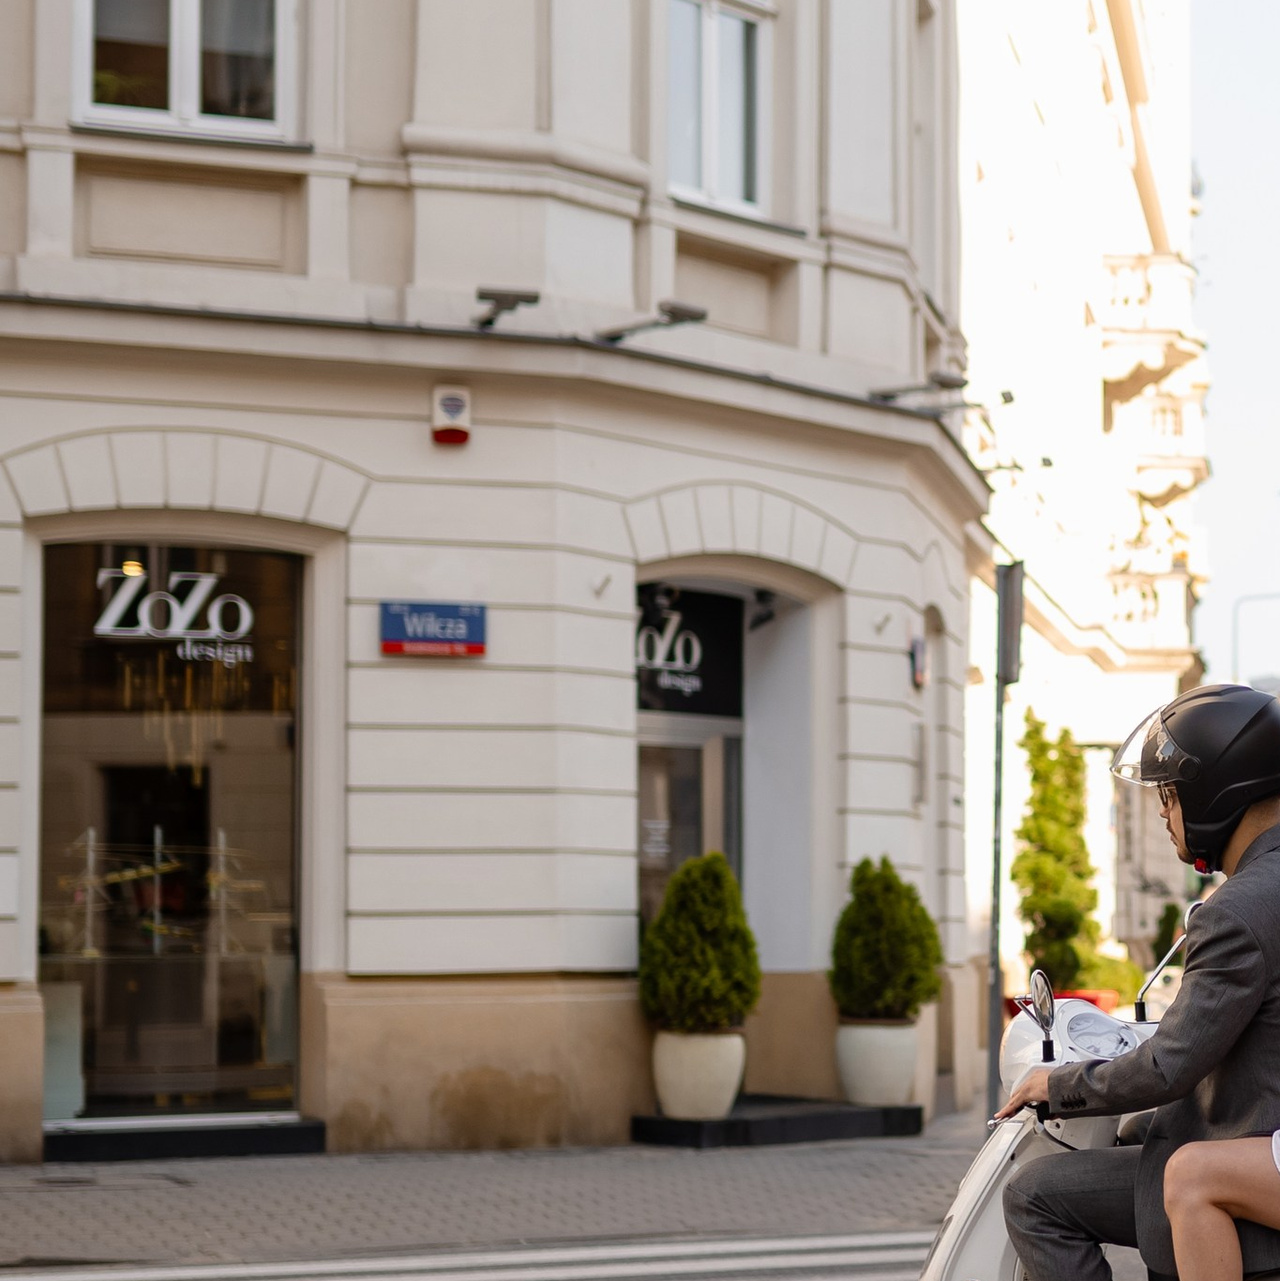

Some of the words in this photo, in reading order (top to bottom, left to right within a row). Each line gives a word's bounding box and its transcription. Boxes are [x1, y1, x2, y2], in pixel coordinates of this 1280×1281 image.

[94, 568, 253, 641] ZoZo
[403, 612, 467, 639] Wilcza
[636, 609, 702, 673] oZo
[177, 637, 252, 668] design
[657, 670, 702, 697] design
